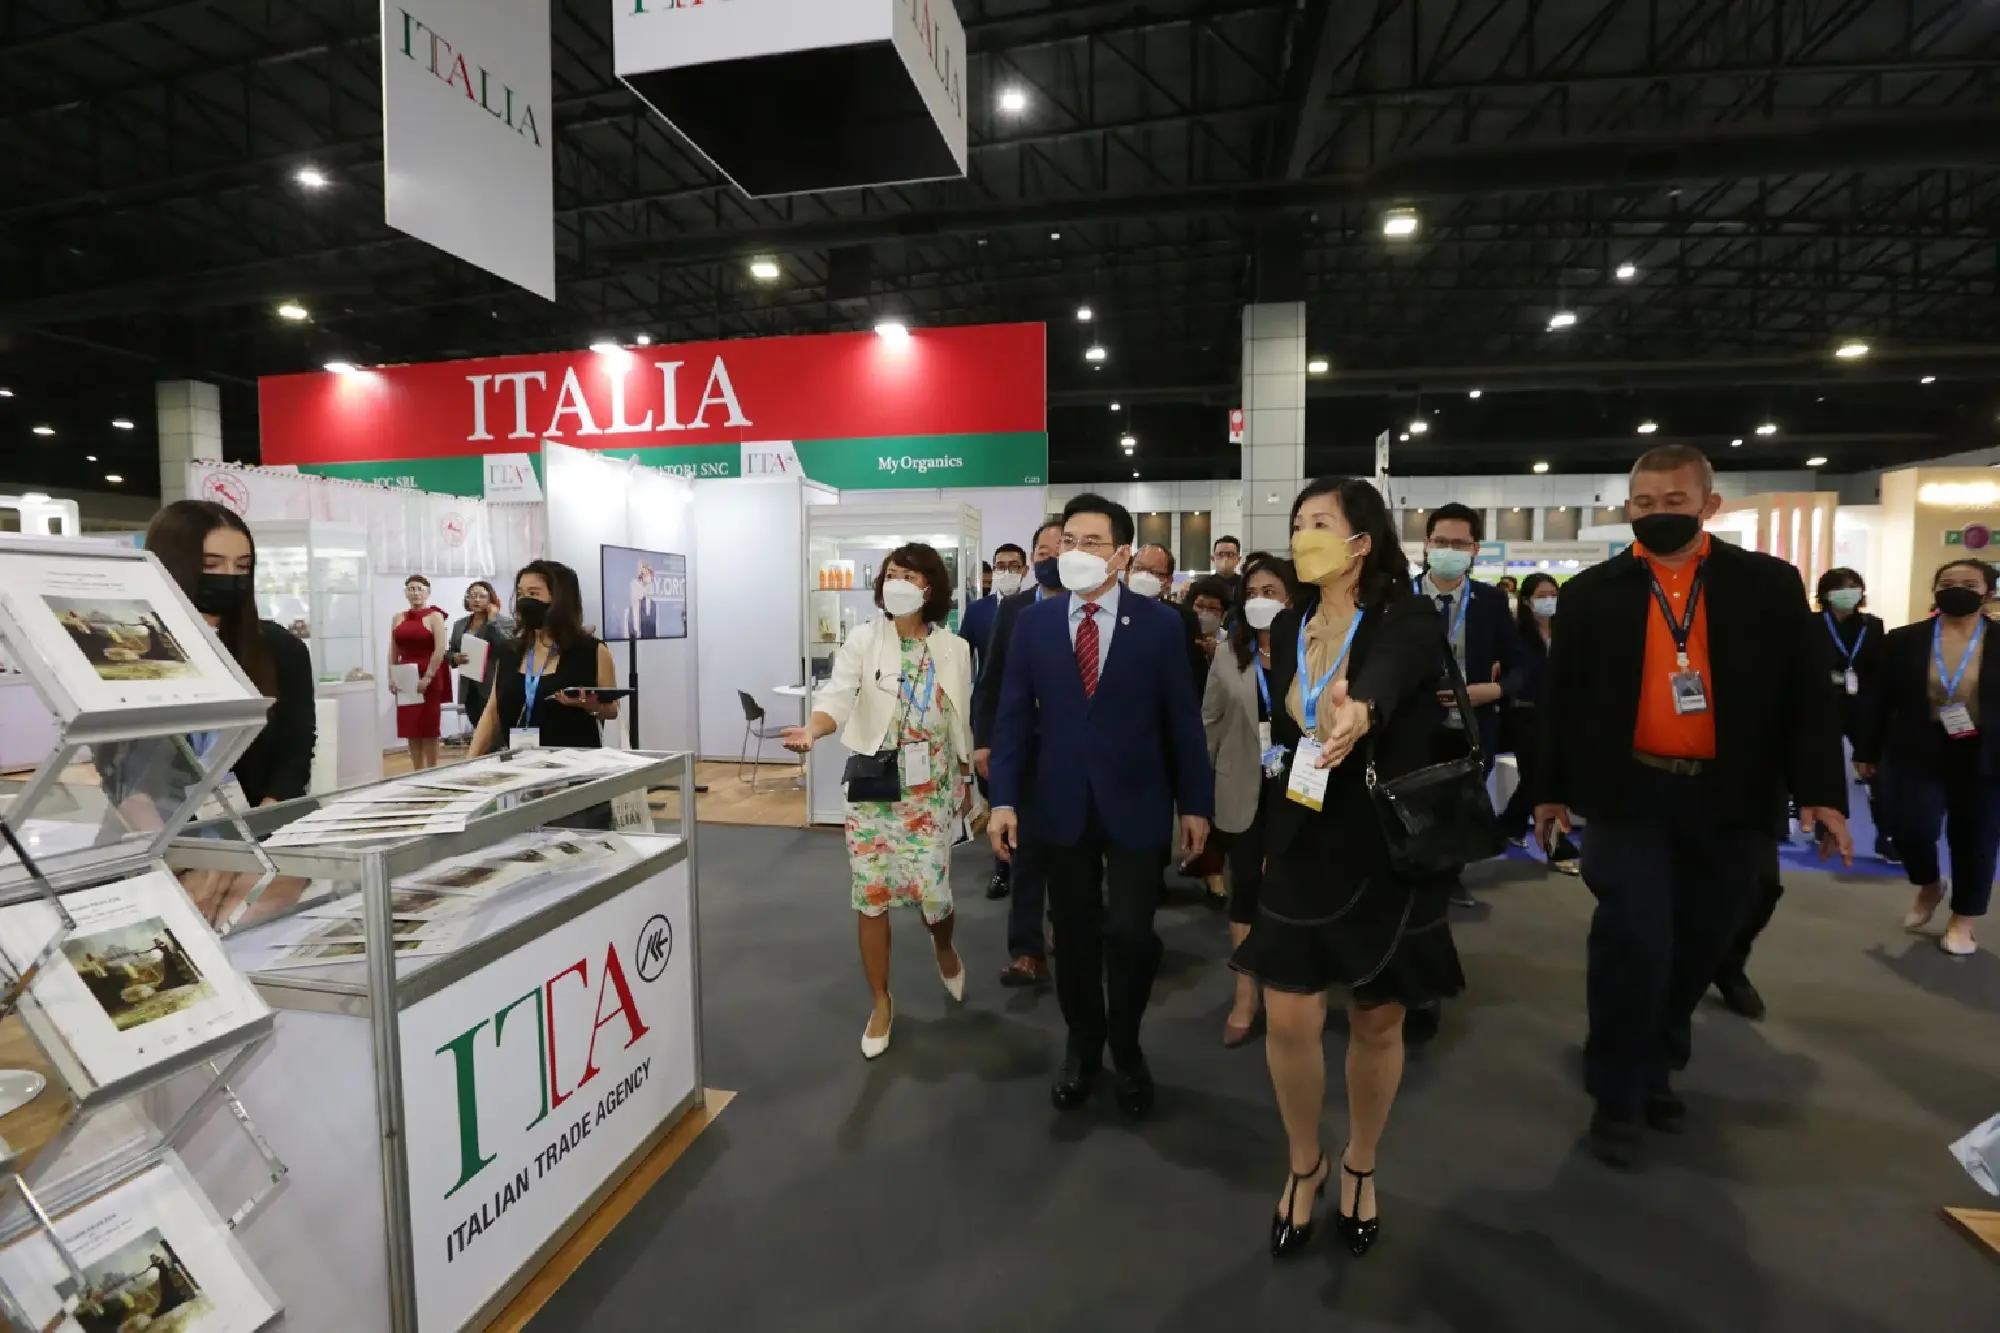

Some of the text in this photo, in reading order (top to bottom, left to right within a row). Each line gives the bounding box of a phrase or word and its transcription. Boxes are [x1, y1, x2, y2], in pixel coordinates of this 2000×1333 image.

[399, 8, 542, 148] ITALIA
[902, 0, 962, 119] ALIA
[466, 355, 753, 441] ITALIA
[700, 462, 729, 476] SNC
[435, 941, 650, 1200] ITA
[446, 1056, 652, 1264] ITALIAN TRADE AGENCY
